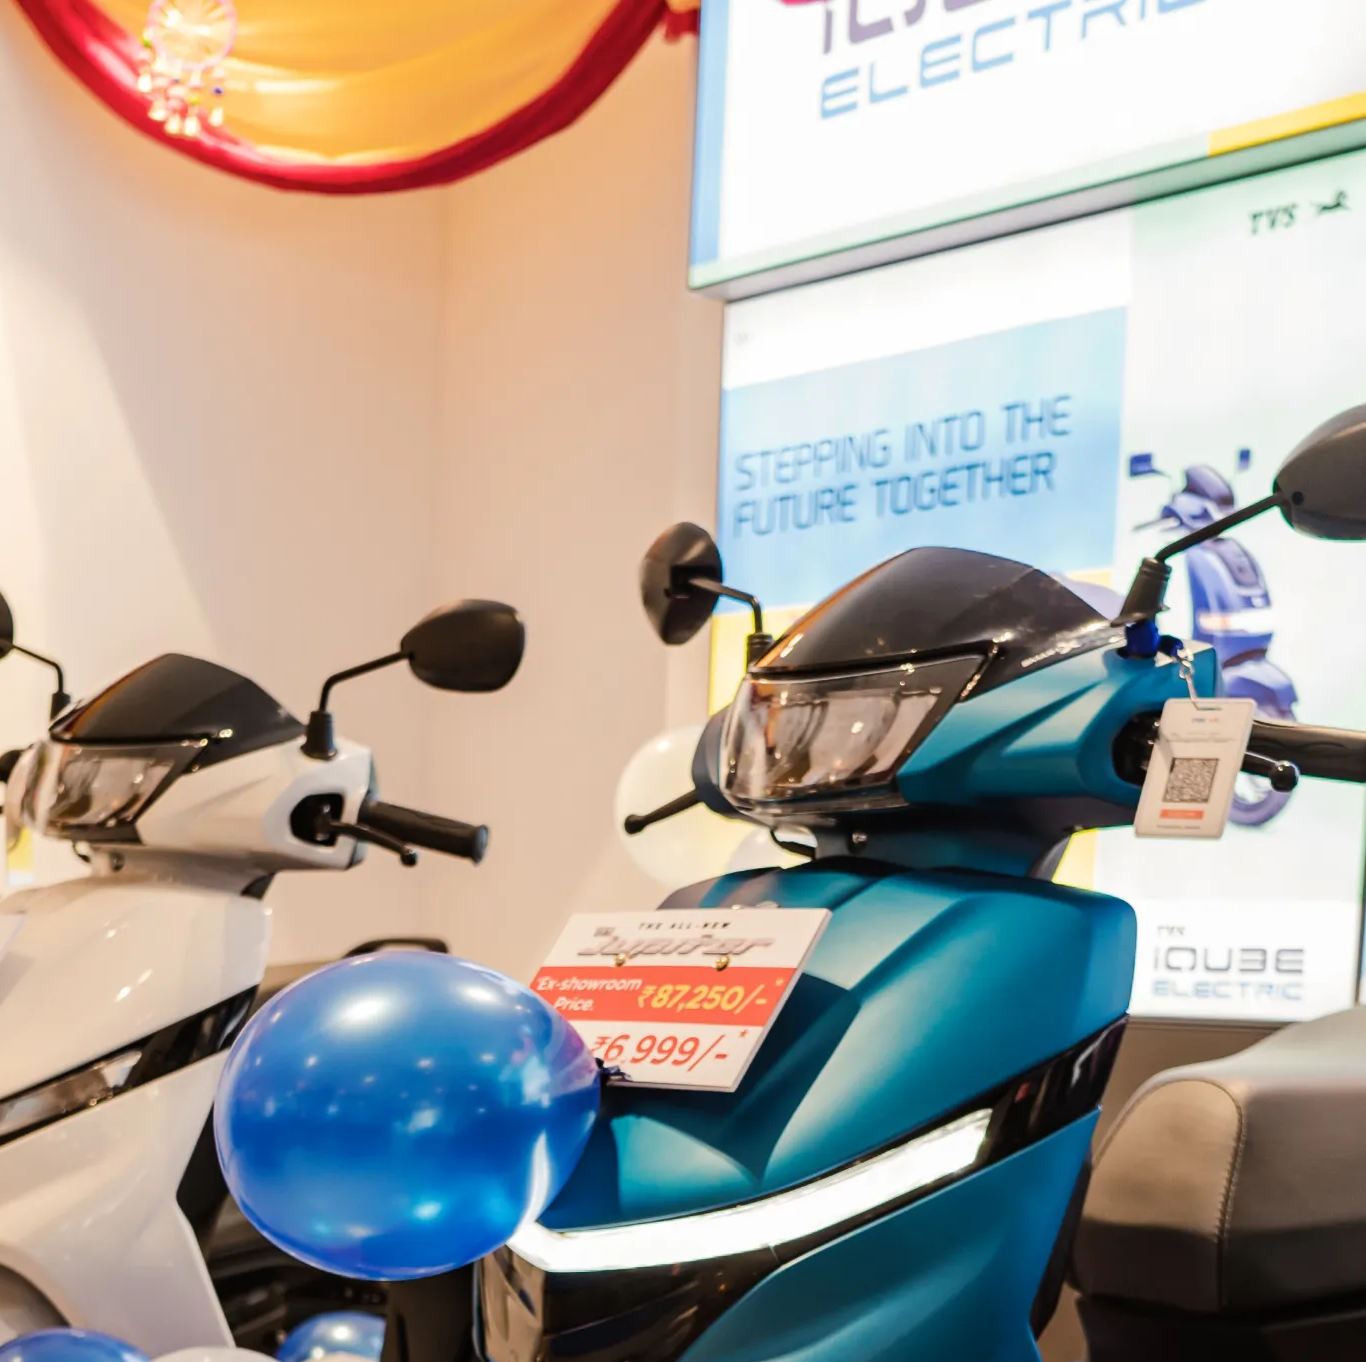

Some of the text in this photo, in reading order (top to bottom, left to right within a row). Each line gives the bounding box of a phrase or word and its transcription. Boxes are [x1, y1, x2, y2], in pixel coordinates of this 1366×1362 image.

[735, 393, 1071, 491] STEPPING INTO THE
[733, 452, 1057, 540] FUTURE TOGETHER
[1152, 980, 1304, 1001] ELECTRIC
